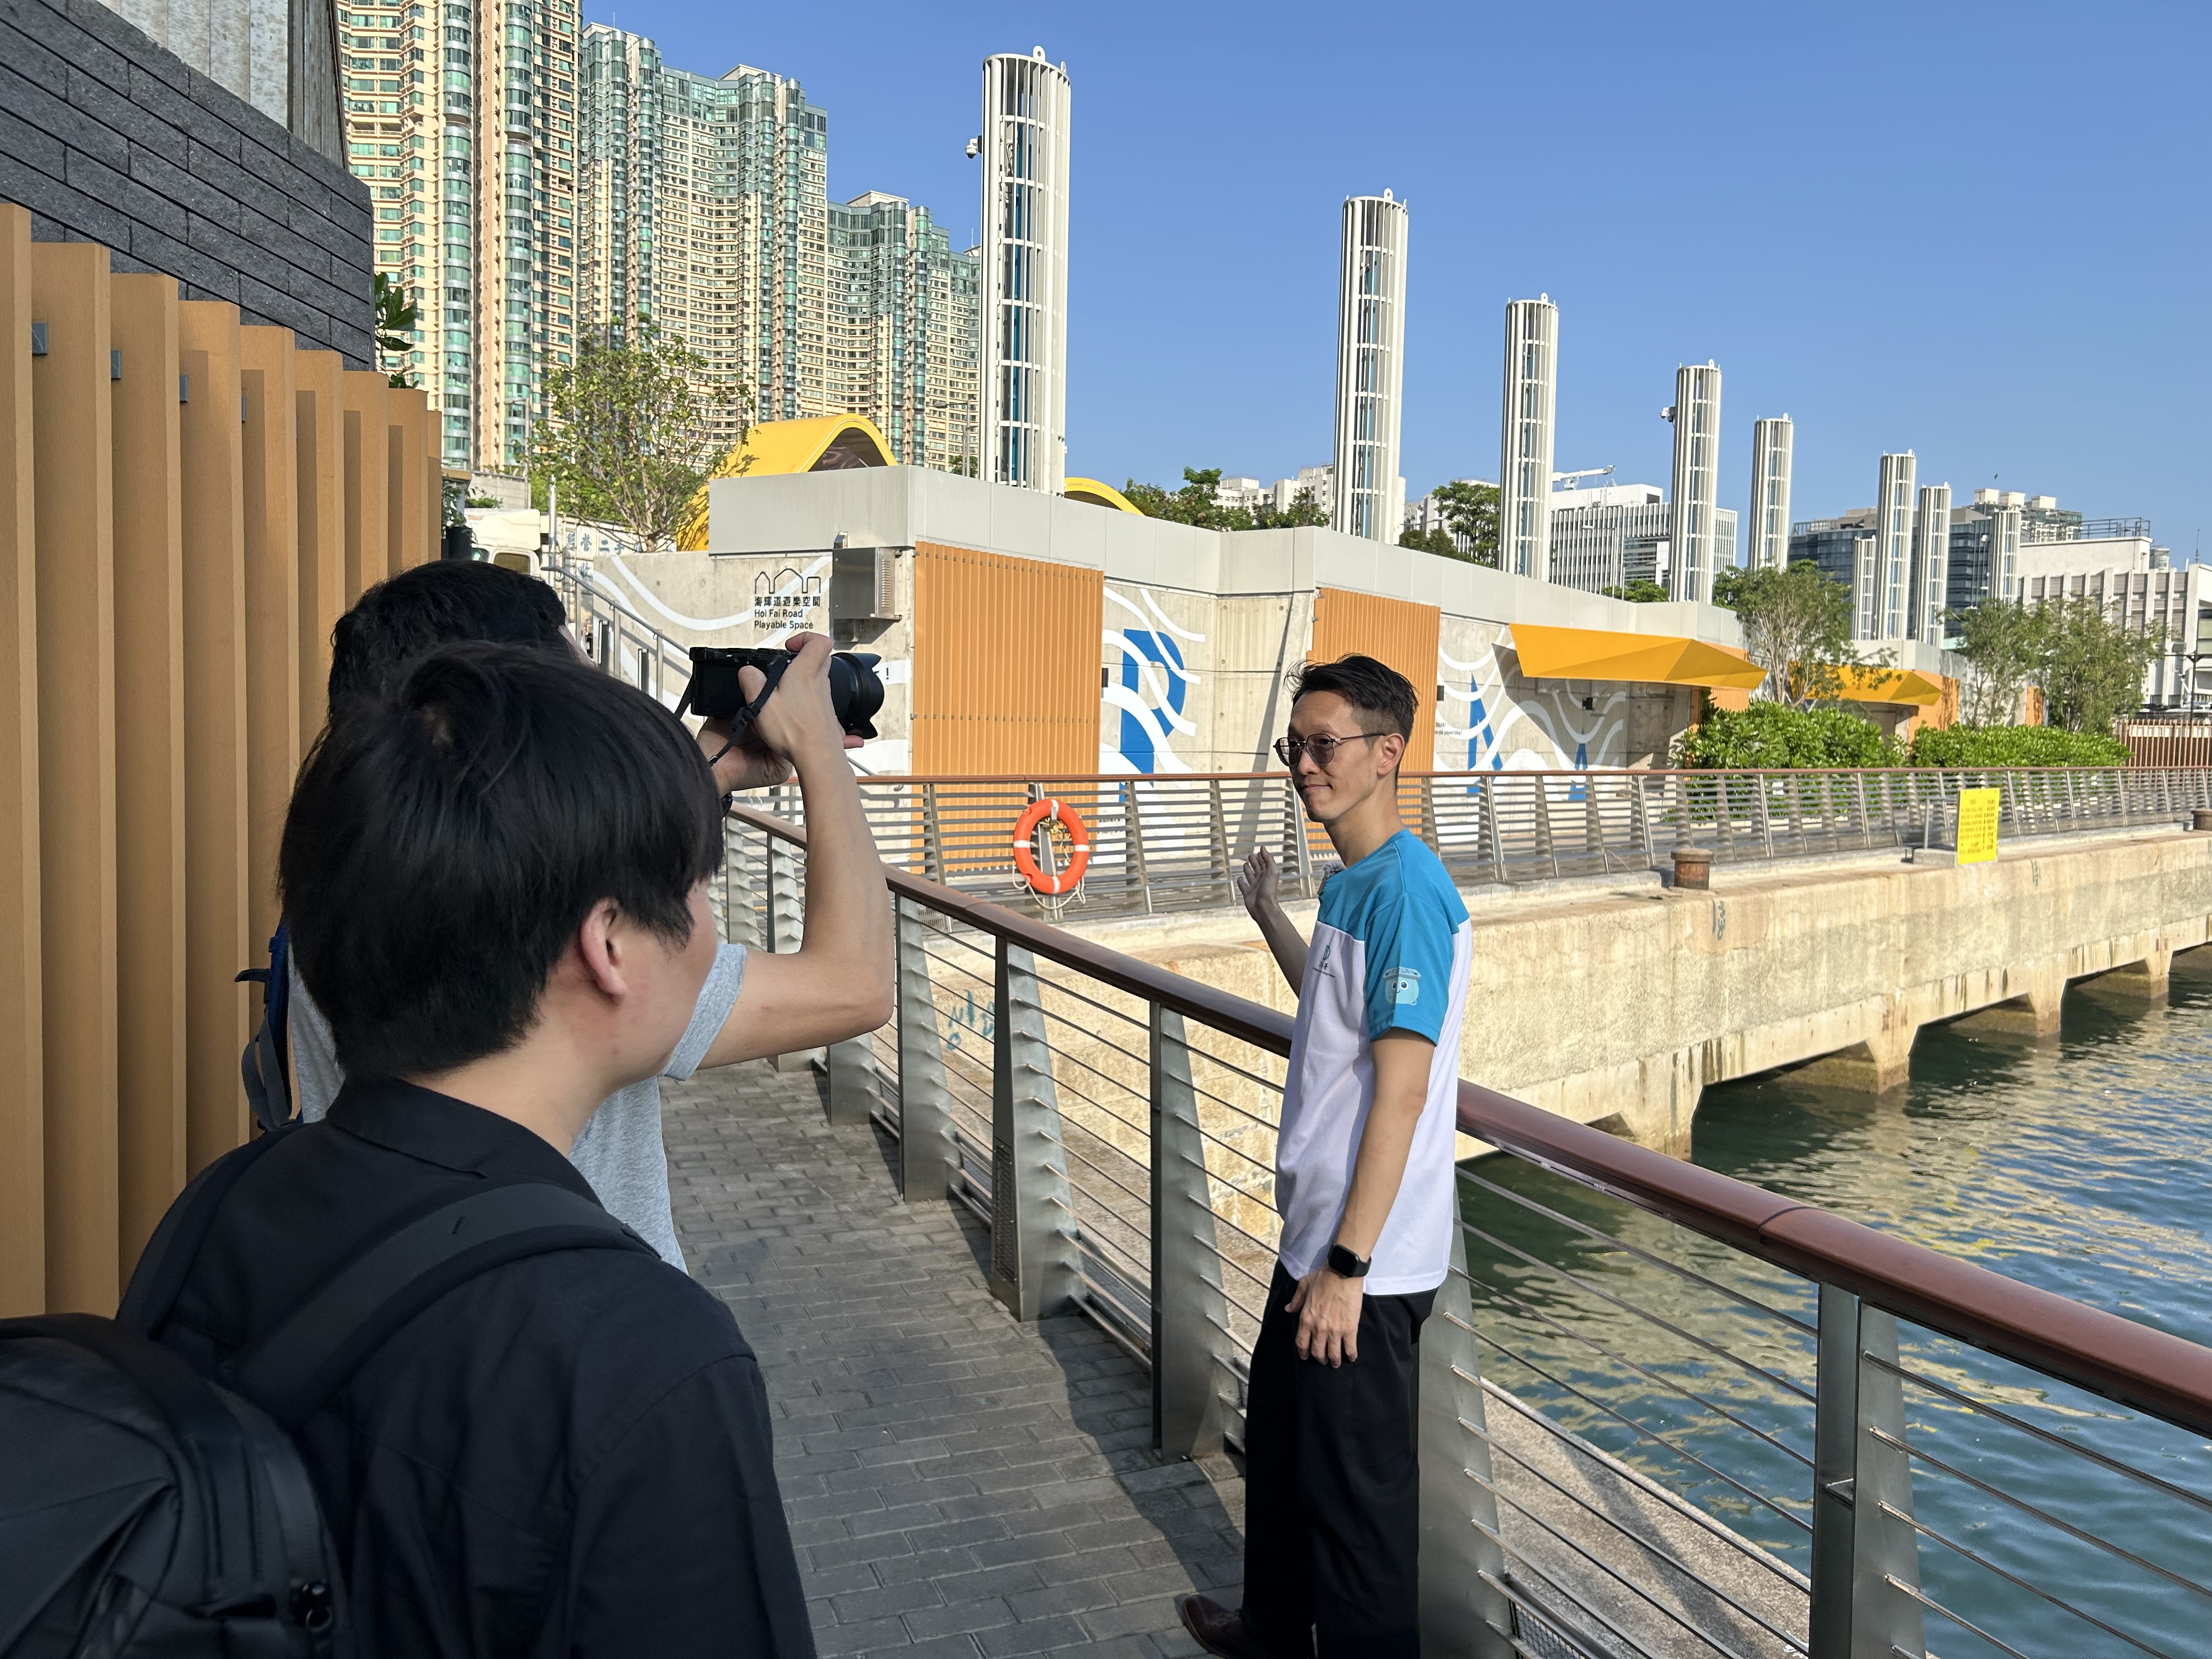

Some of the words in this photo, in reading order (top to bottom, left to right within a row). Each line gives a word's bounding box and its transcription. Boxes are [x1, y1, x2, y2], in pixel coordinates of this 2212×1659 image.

[754, 596, 821, 607] 海輝道遊樂空間
[754, 608, 767, 618] Hoi
[769, 608, 780, 618] Fai
[782, 608, 803, 618] Road
[754, 620, 787, 630] Playable
[789, 620, 814, 630] Space
